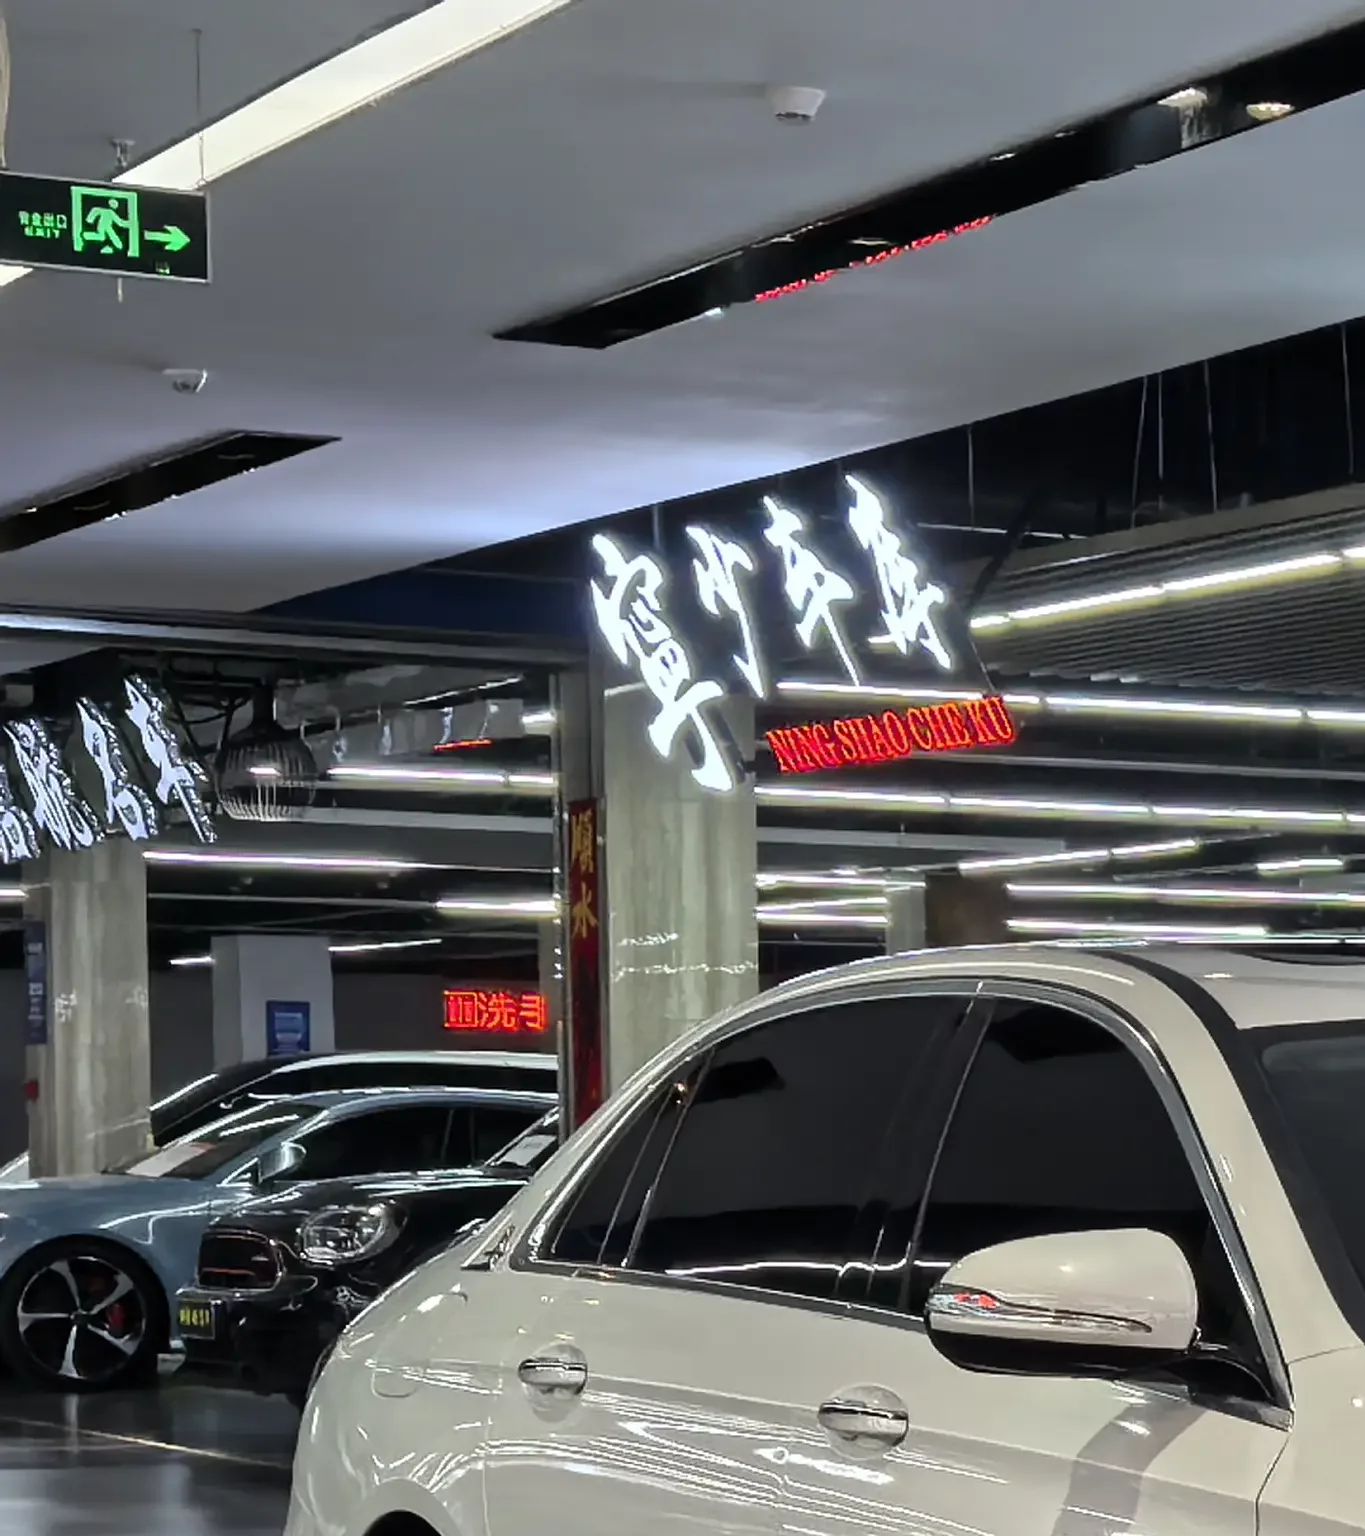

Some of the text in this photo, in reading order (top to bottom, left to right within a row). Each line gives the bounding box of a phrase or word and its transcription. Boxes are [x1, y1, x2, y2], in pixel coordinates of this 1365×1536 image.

[765, 696, 1014, 773] NING SHAO CHE KU
